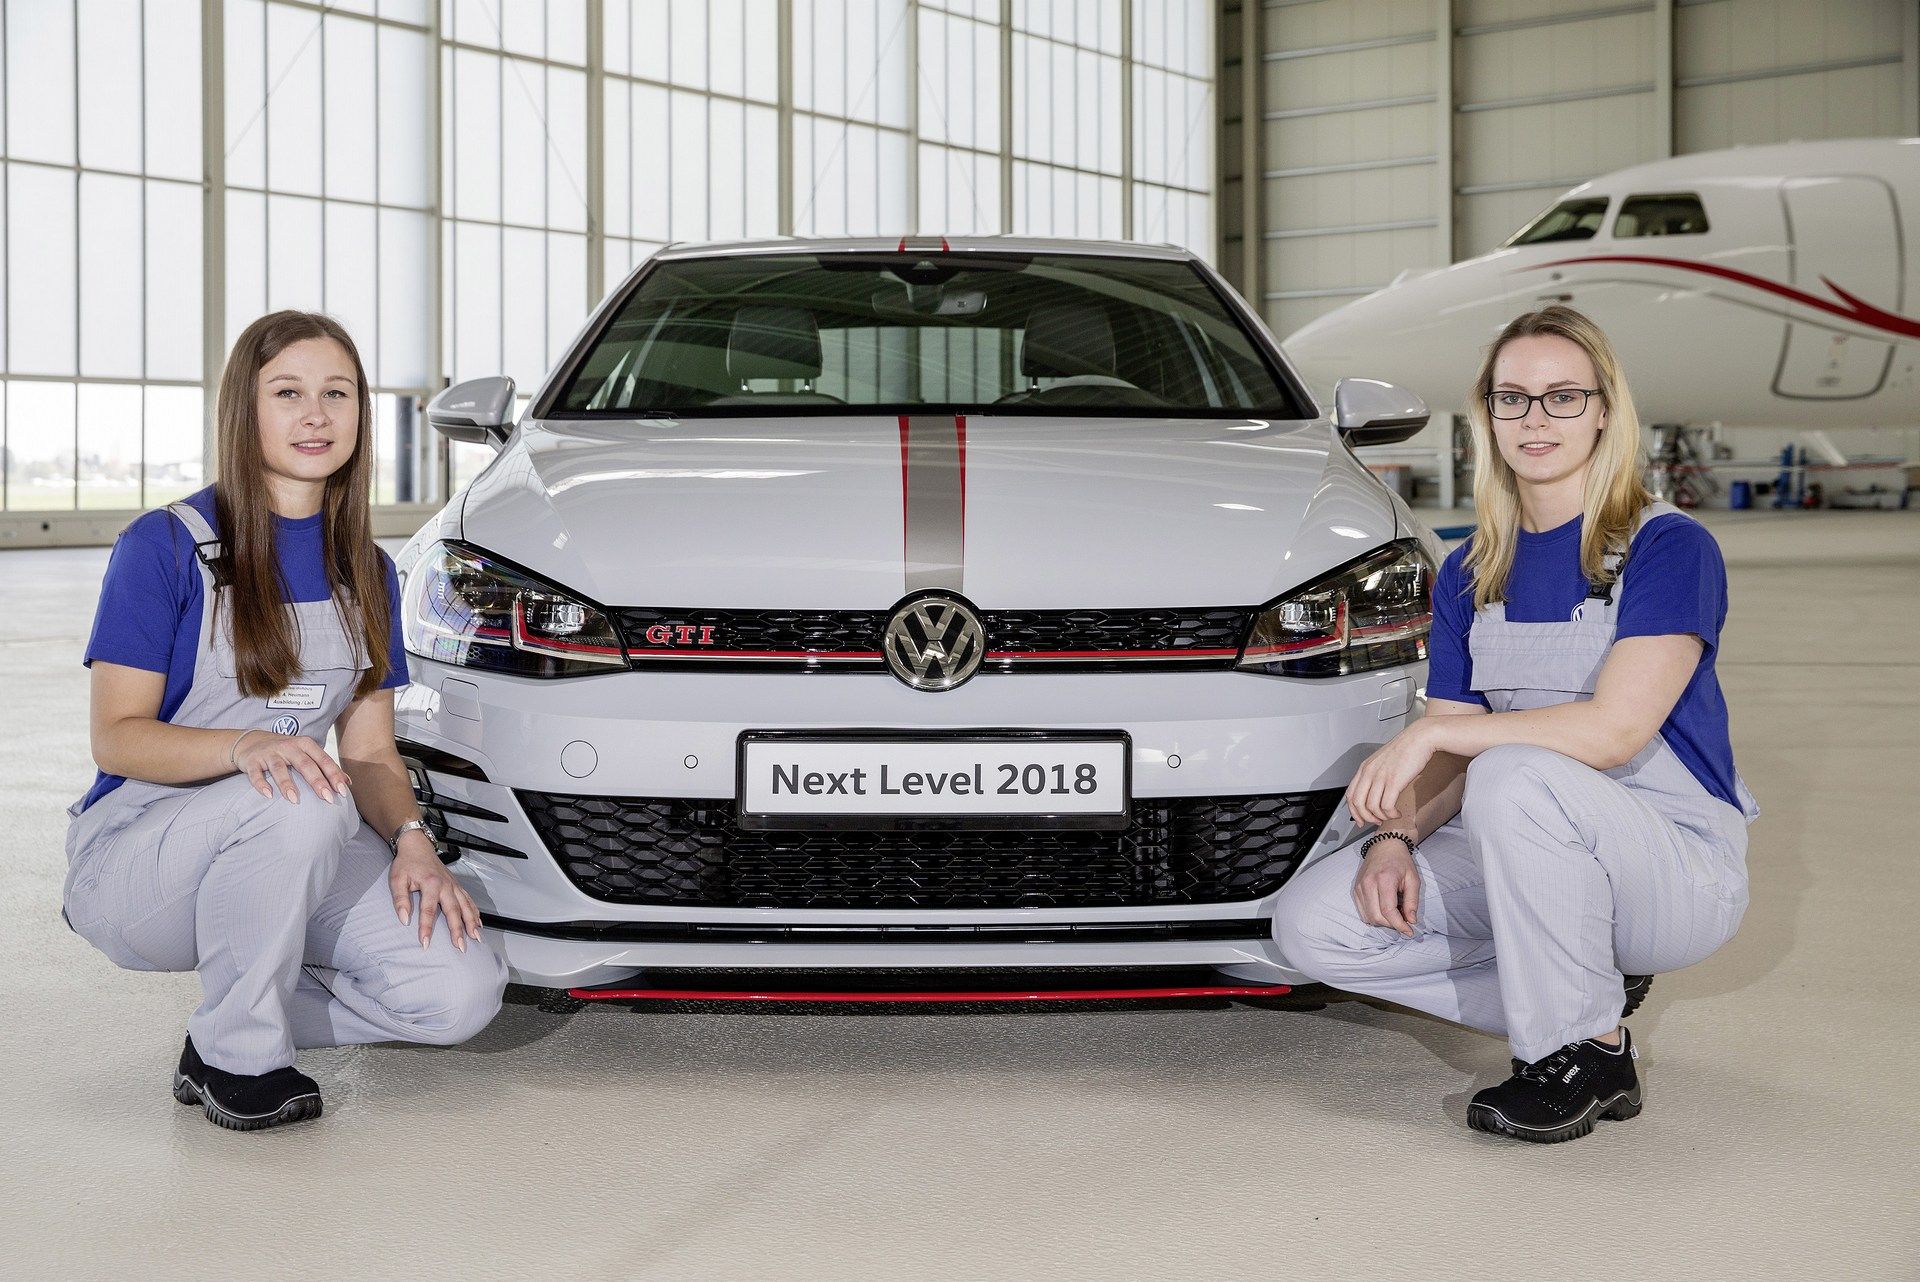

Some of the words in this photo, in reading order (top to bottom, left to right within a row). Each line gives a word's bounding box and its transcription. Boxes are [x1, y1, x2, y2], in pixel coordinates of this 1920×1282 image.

[646, 624, 716, 645] GTI
[772, 763, 867, 795] Next
[880, 763, 984, 795] Level
[996, 763, 1098, 795] 2018
[1561, 1064, 1581, 1084] uvex
